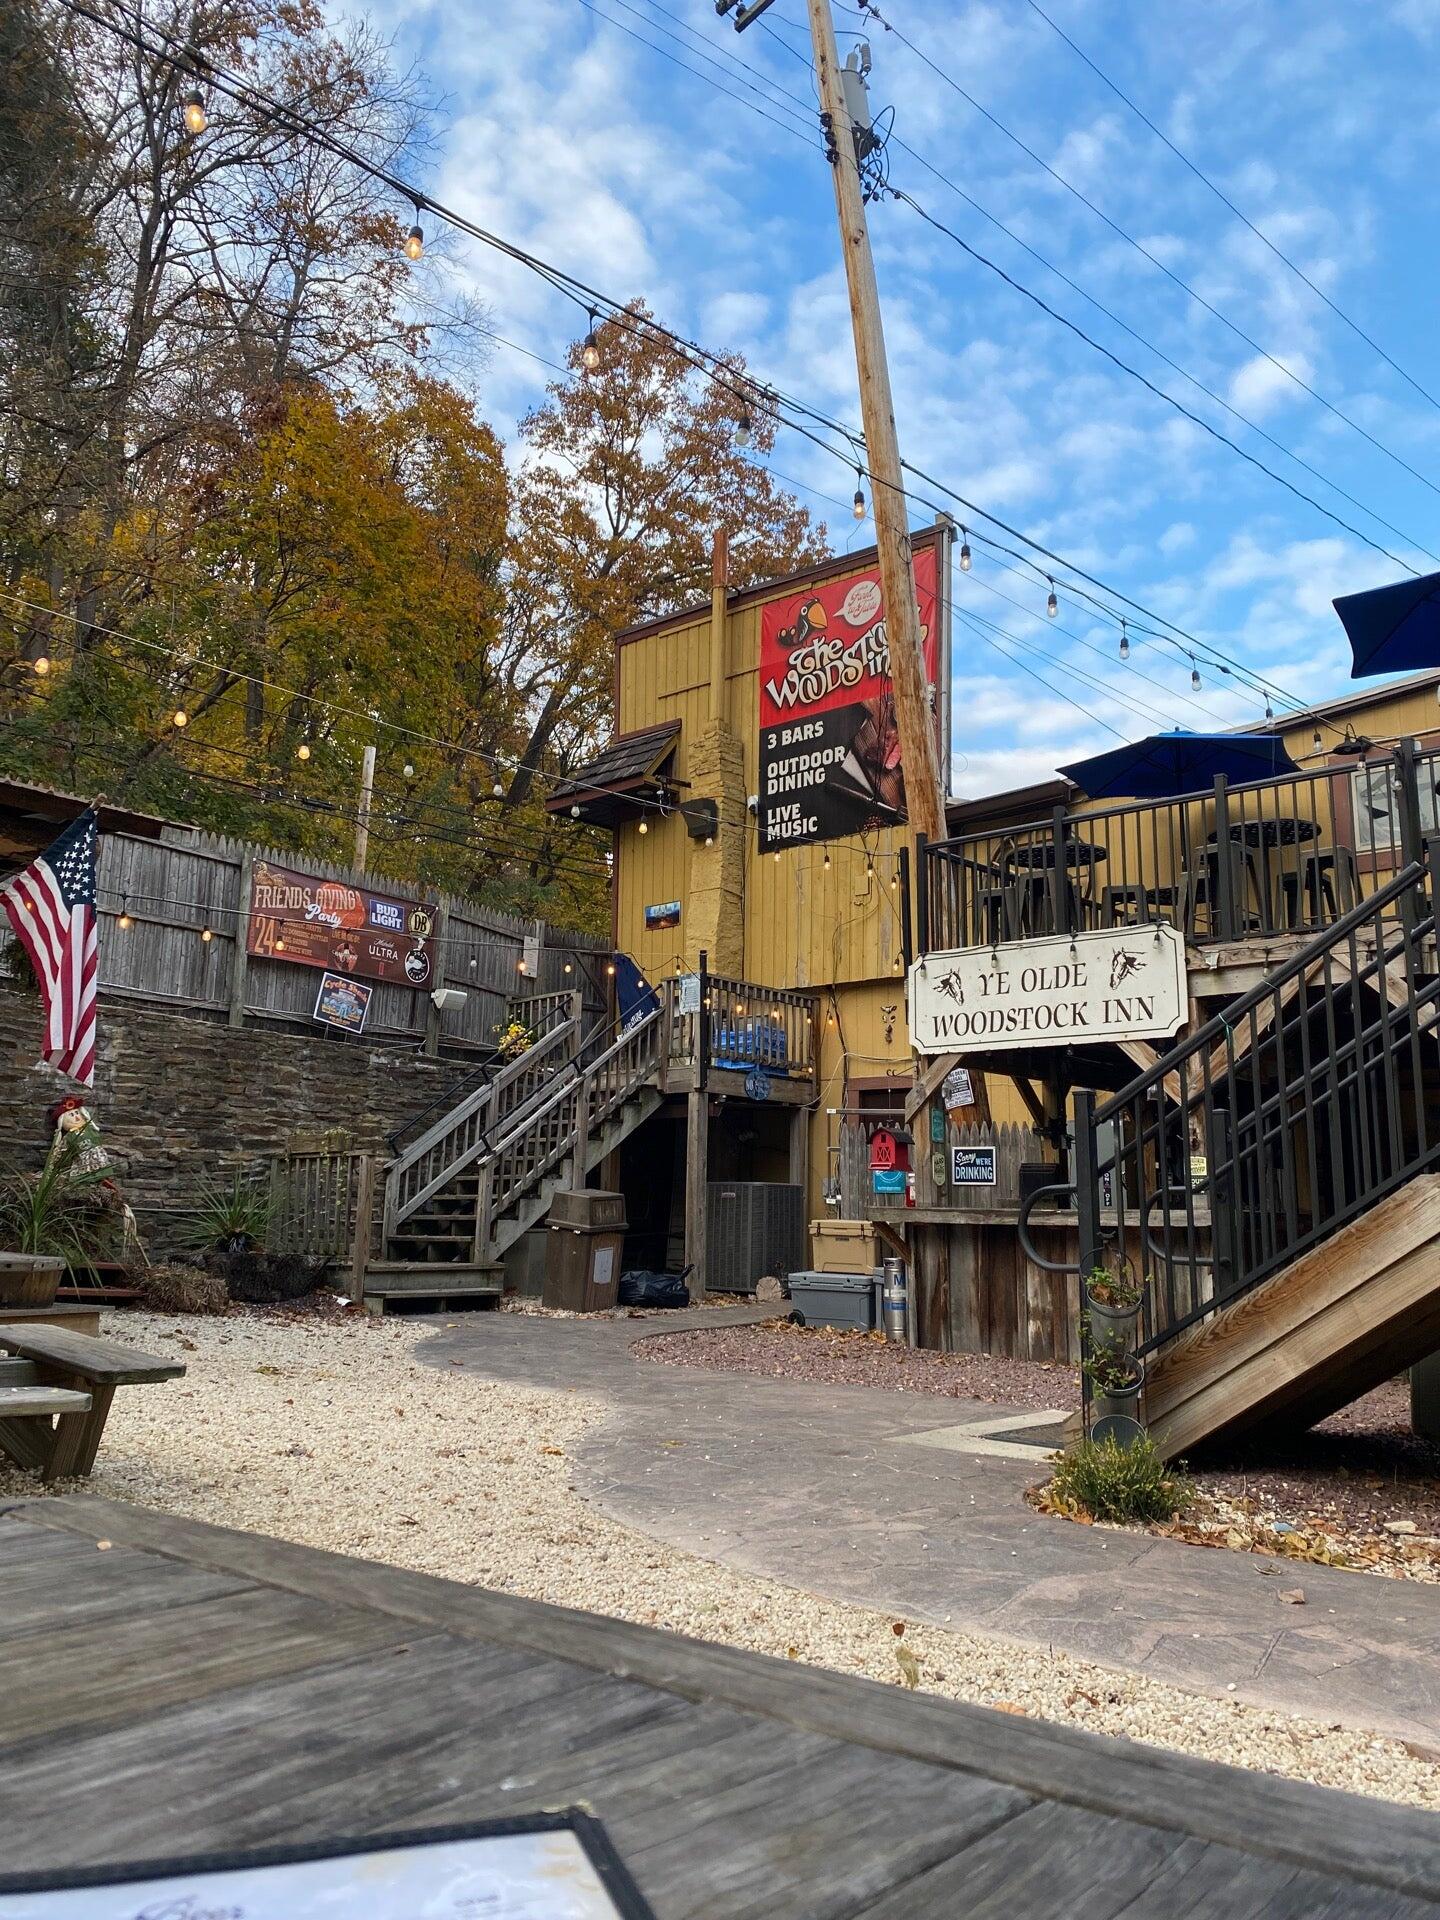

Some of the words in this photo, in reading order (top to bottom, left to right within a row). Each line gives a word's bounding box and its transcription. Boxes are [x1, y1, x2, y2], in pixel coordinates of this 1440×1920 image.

[788, 635, 843, 676] The
[767, 733, 777, 750] 3
[782, 720, 824, 747] BARS
[767, 746, 846, 779] OUTDOOR
[767, 767, 826, 796] DINING
[767, 803, 801, 826] LIVE
[767, 816, 818, 842] MUSIC
[304, 903, 342, 929] Party
[371, 912, 402, 931] LIGHT
[376, 904, 398, 919] BUD
[254, 916, 275, 956] 24
[368, 945, 399, 960] ULTRA
[978, 970, 1011, 997] YE
[1020, 962, 1088, 993] OLDE
[932, 1001, 1090, 1038] WOODSTOCK
[1102, 995, 1157, 1024] INN
[956, 1151, 977, 1164] Sorry
[955, 1166, 993, 1180] DRINKING
